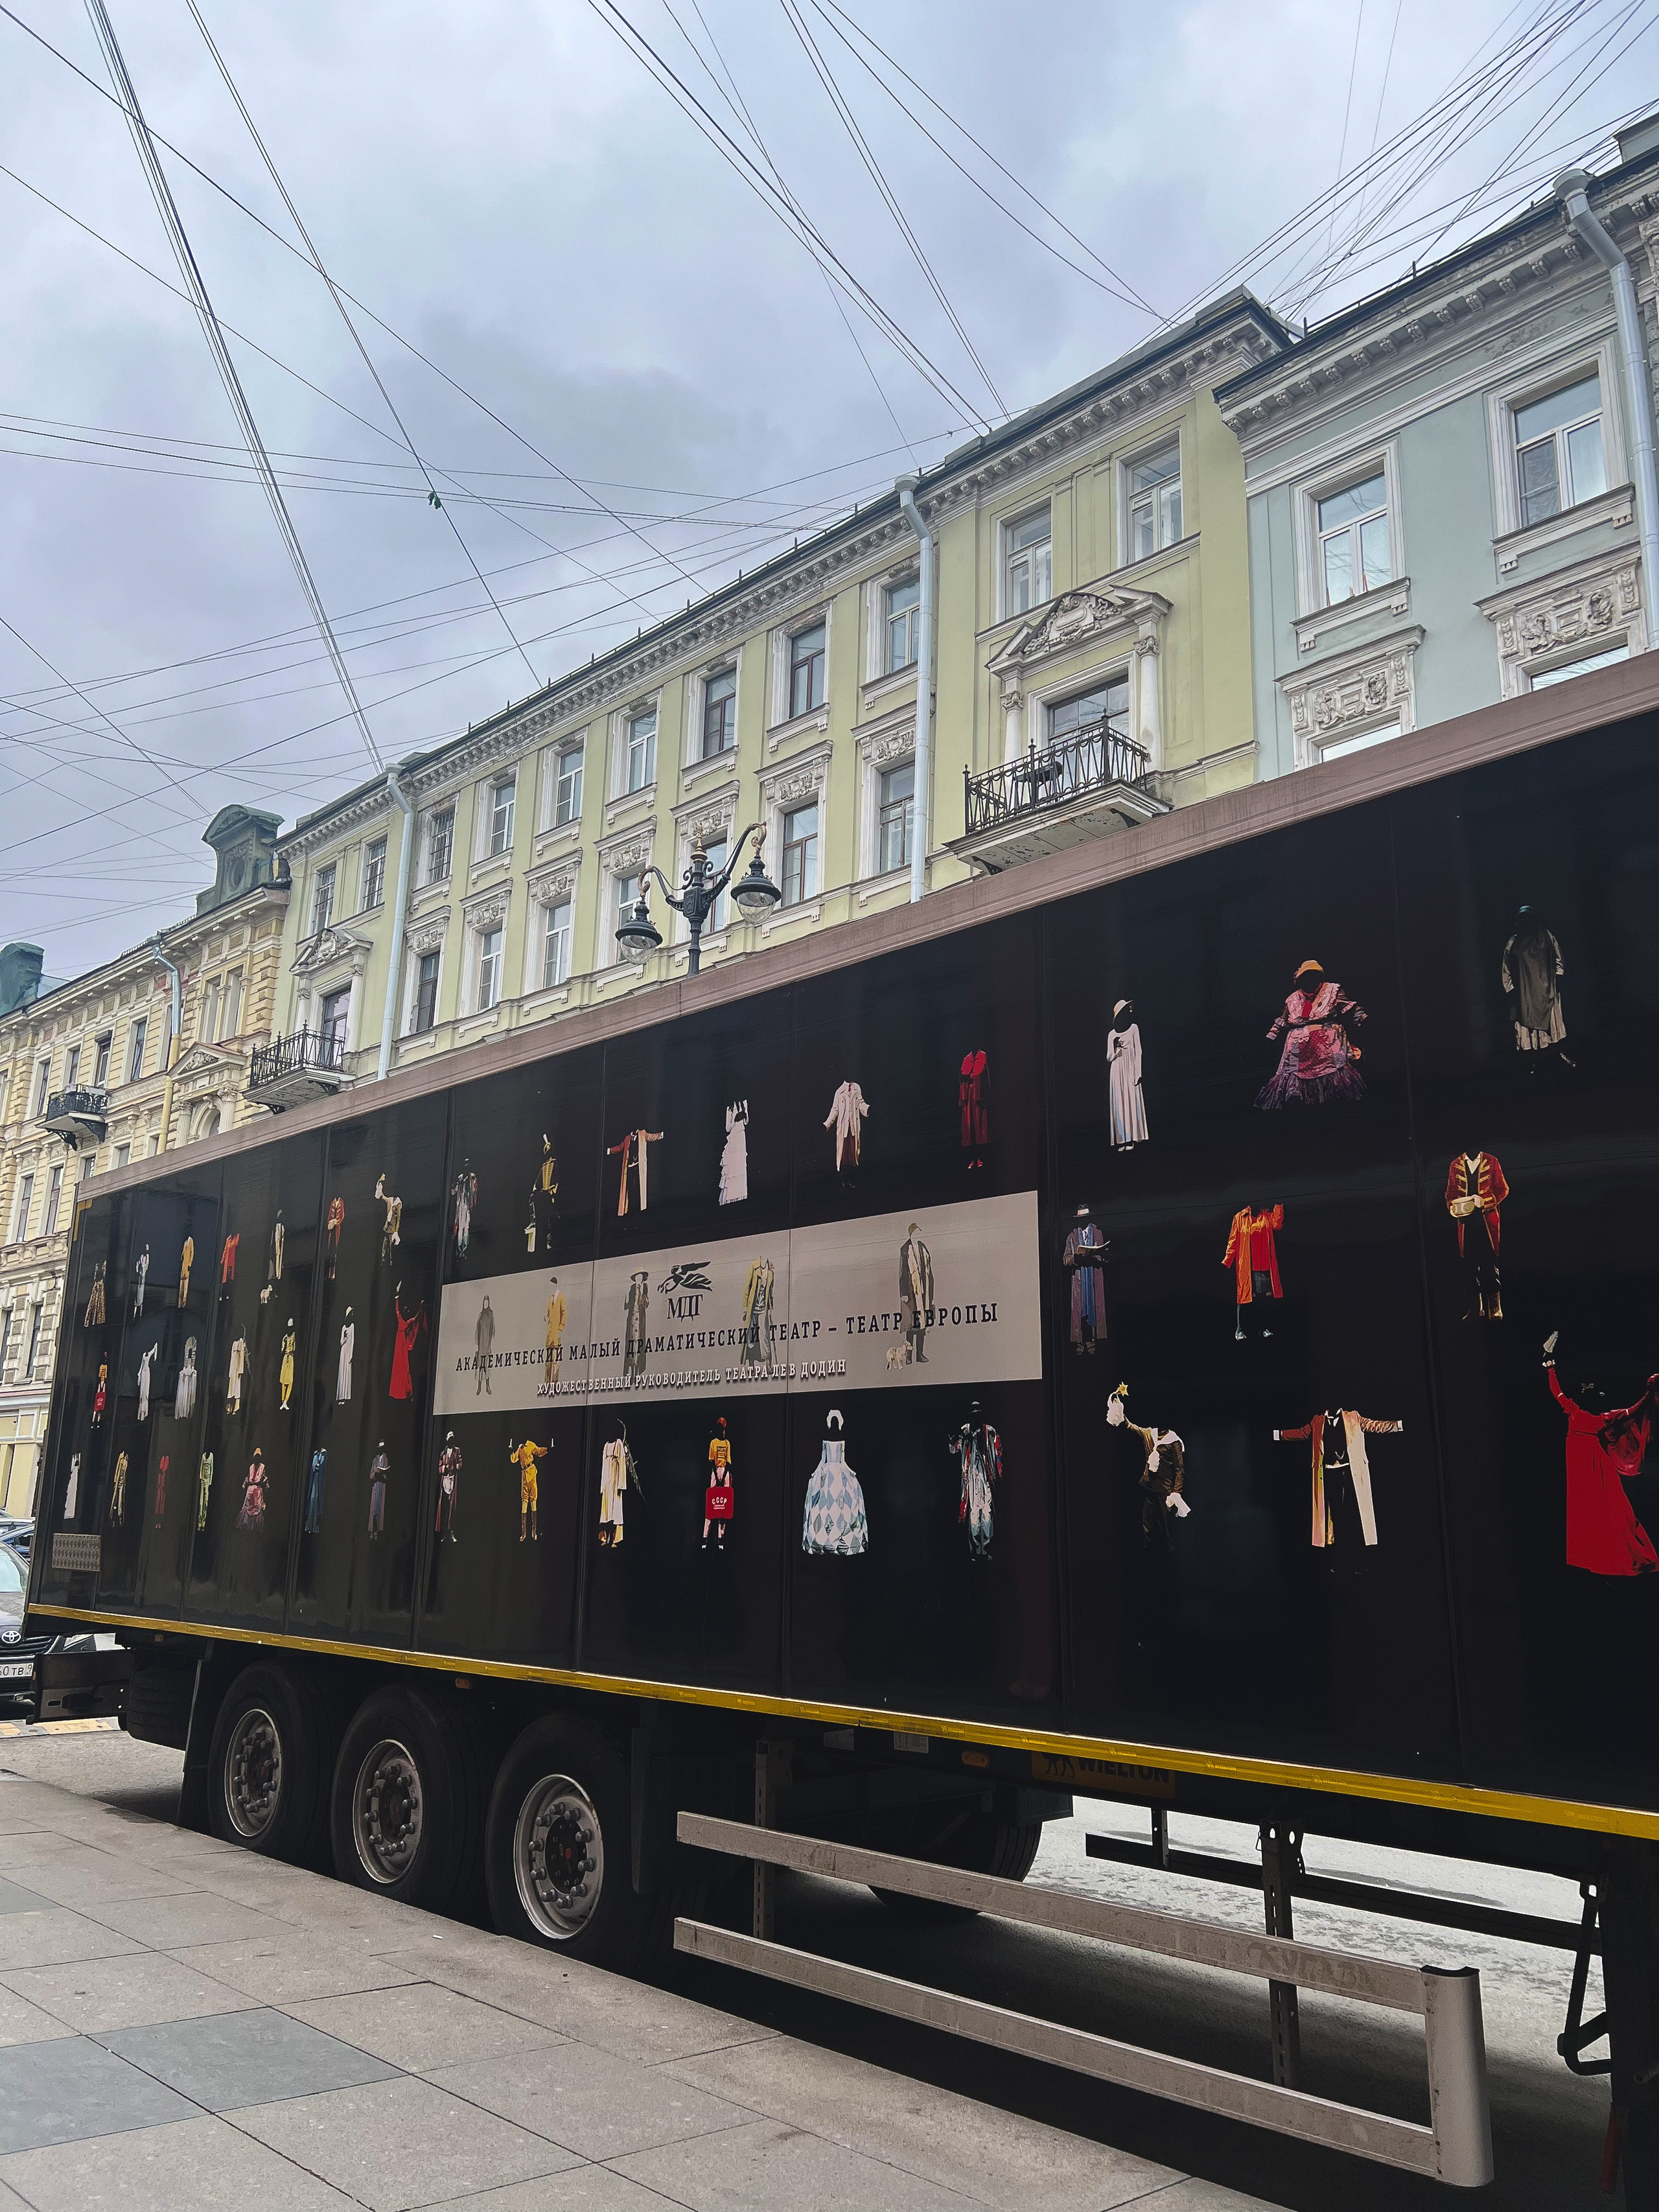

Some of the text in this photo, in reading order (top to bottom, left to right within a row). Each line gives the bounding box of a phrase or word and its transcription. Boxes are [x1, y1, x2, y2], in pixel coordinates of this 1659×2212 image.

[456, 1344, 563, 1371] АКАДЕМИЧЕСКИЙ
[569, 1338, 621, 1360] МАЛЫЙ
[626, 1324, 760, 1356] ДРАМАТИЧЕСКИЙ
[769, 1320, 822, 1342] ТЕАТР
[845, 1312, 903, 1334] ТЕАТР
[912, 1303, 998, 1329] ЕВРОПЫ
[537, 1358, 846, 1395] ХУДОЖЕСТВЕННЫЙ РУКОВОДИТЕЛЬ ТЕАТРА ЛЕВ ДОДИН
